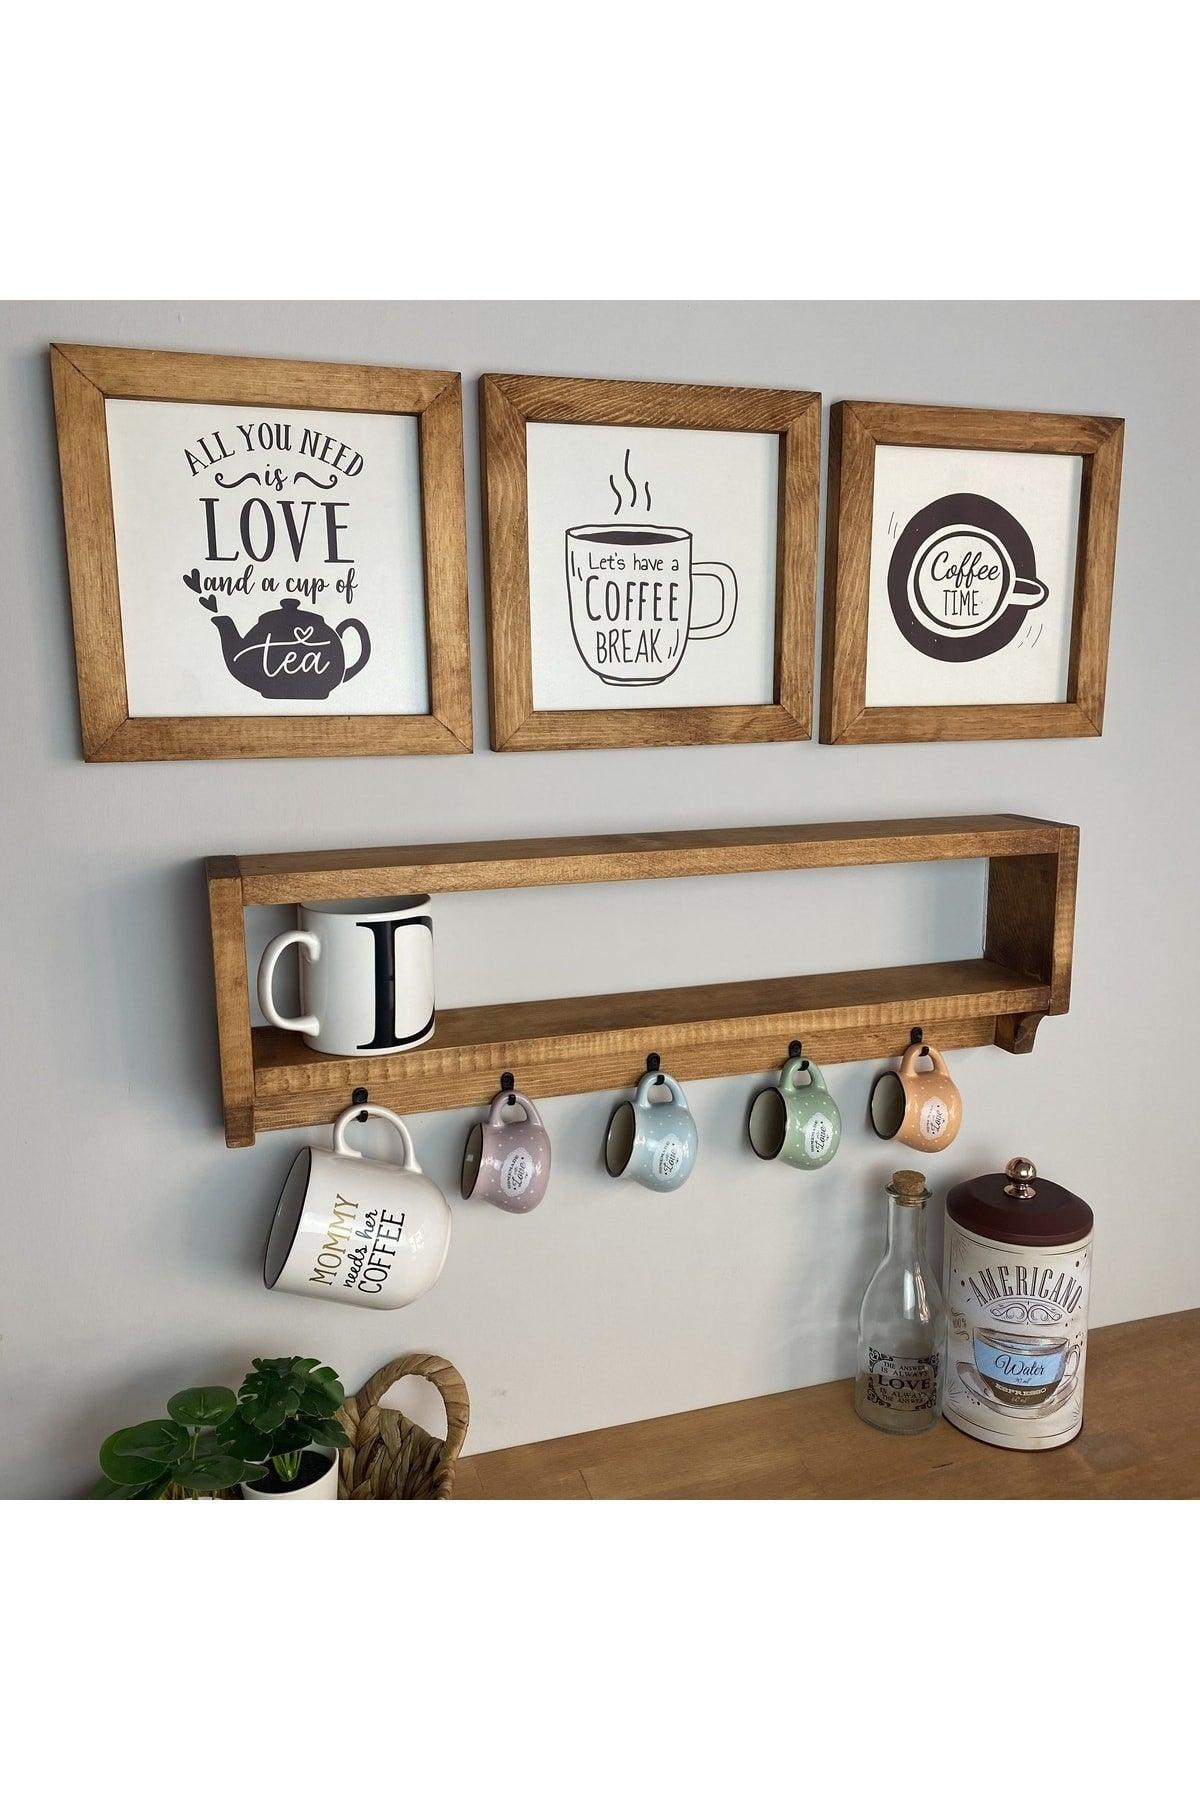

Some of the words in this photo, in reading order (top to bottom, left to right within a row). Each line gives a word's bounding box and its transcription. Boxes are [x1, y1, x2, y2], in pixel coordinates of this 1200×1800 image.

[184, 431, 236, 476] ALL
[236, 422, 292, 452] YOU
[299, 428, 364, 477] NEED
[264, 463, 288, 491] is
[199, 497, 355, 564] LOVE
[588, 551, 626, 571] Let's
[633, 552, 664, 571] have
[671, 558, 679, 572] a
[930, 550, 1001, 589] Coffee
[203, 564, 256, 596] and
[261, 577, 280, 592] a
[285, 576, 329, 605] cup
[335, 567, 359, 605] of
[585, 575, 679, 622] COFFEE
[942, 589, 980, 617] TIME
[233, 632, 331, 678] tea
[596, 628, 663, 664] BREAK
[815, 1125, 826, 1150] Love
[511, 1162, 527, 1188] Love
[308, 1193, 359, 1286] MOMMY
[354, 1209, 378, 1240] her
[342, 1244, 368, 1288] needs
[357, 1209, 405, 1294] COFFEE
[968, 1265, 1083, 1314] AMERICANO
[878, 1374, 931, 1391] LOVE
[881, 1366, 889, 1374] IS
[883, 1361, 896, 1370] THE
[994, 1354, 1046, 1376] Water
